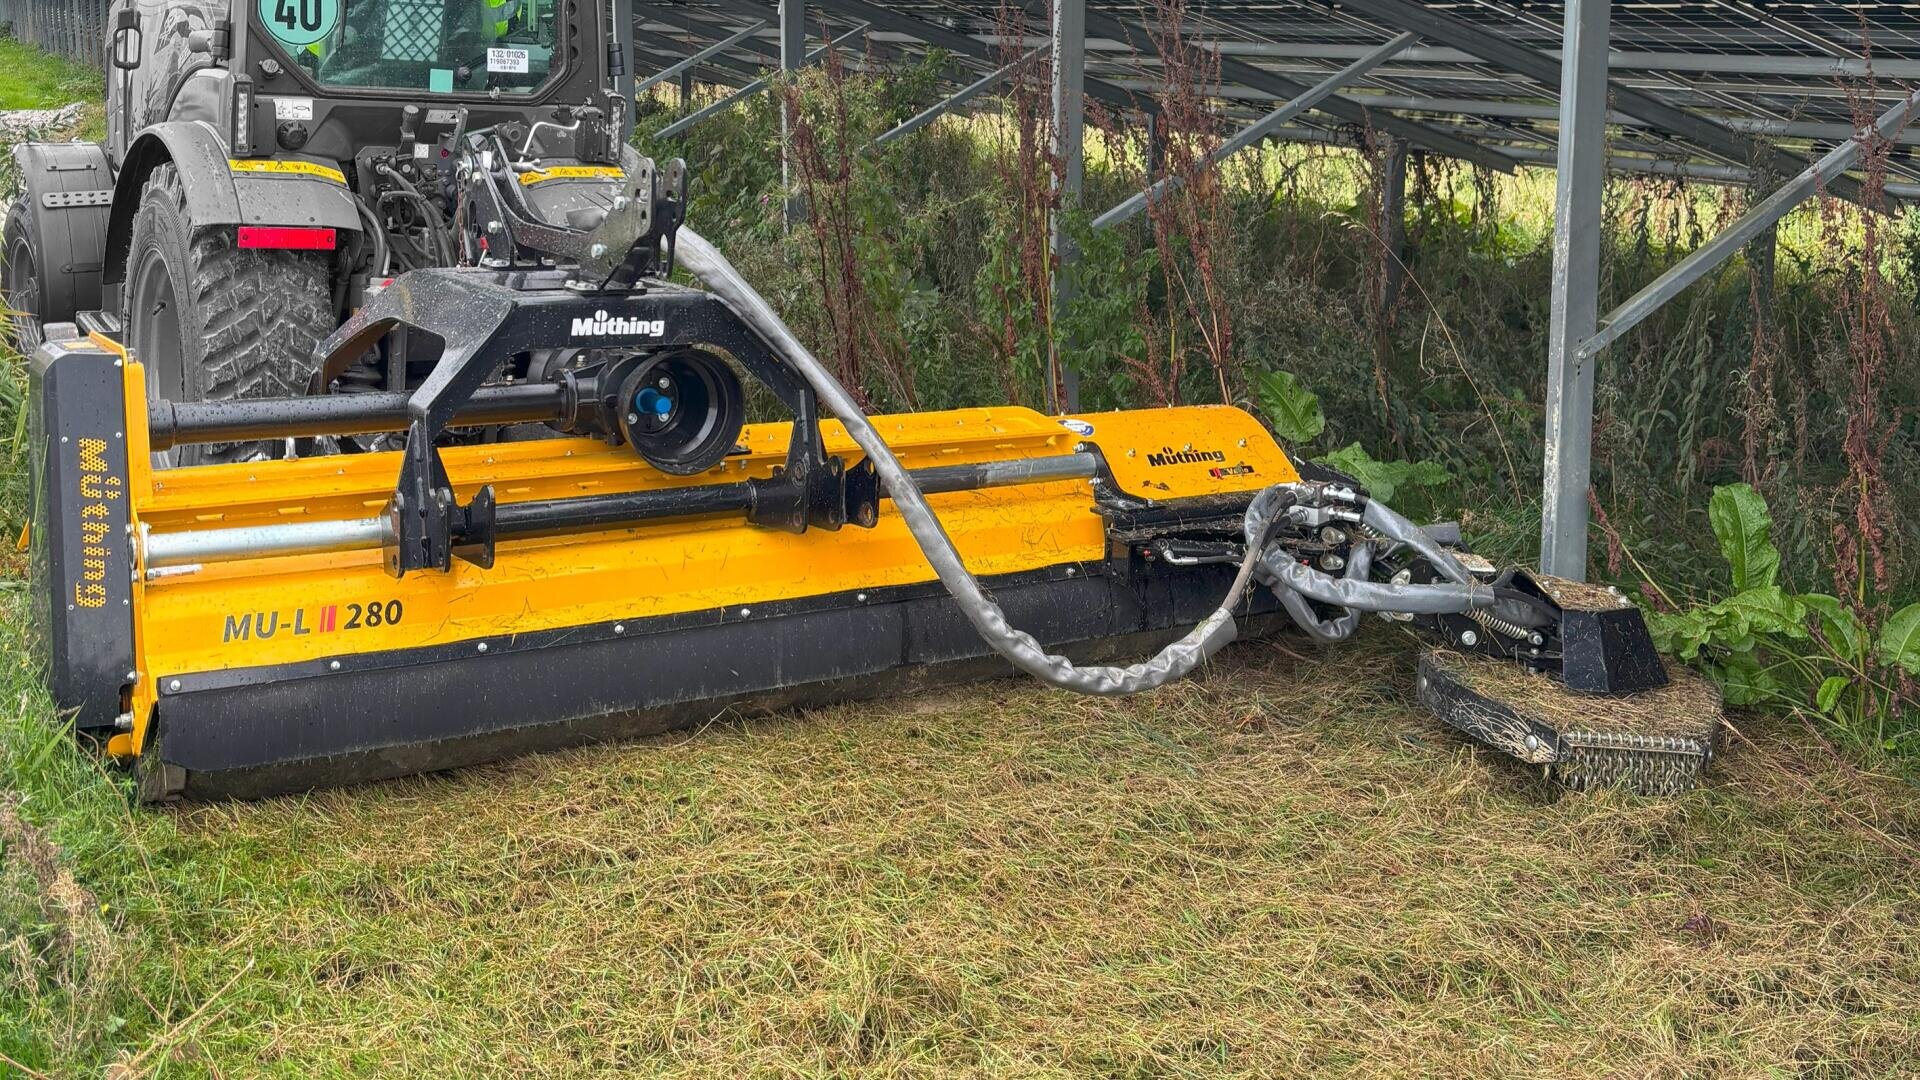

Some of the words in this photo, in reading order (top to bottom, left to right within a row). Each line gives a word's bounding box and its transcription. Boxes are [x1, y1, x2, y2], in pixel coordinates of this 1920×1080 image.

[274, 0, 323, 32] 40
[571, 309, 665, 337] Müthing
[1147, 447, 1226, 467] Müthing
[76, 437, 121, 608] Müthing
[223, 608, 311, 643] MU-L
[343, 599, 404, 630] 280
